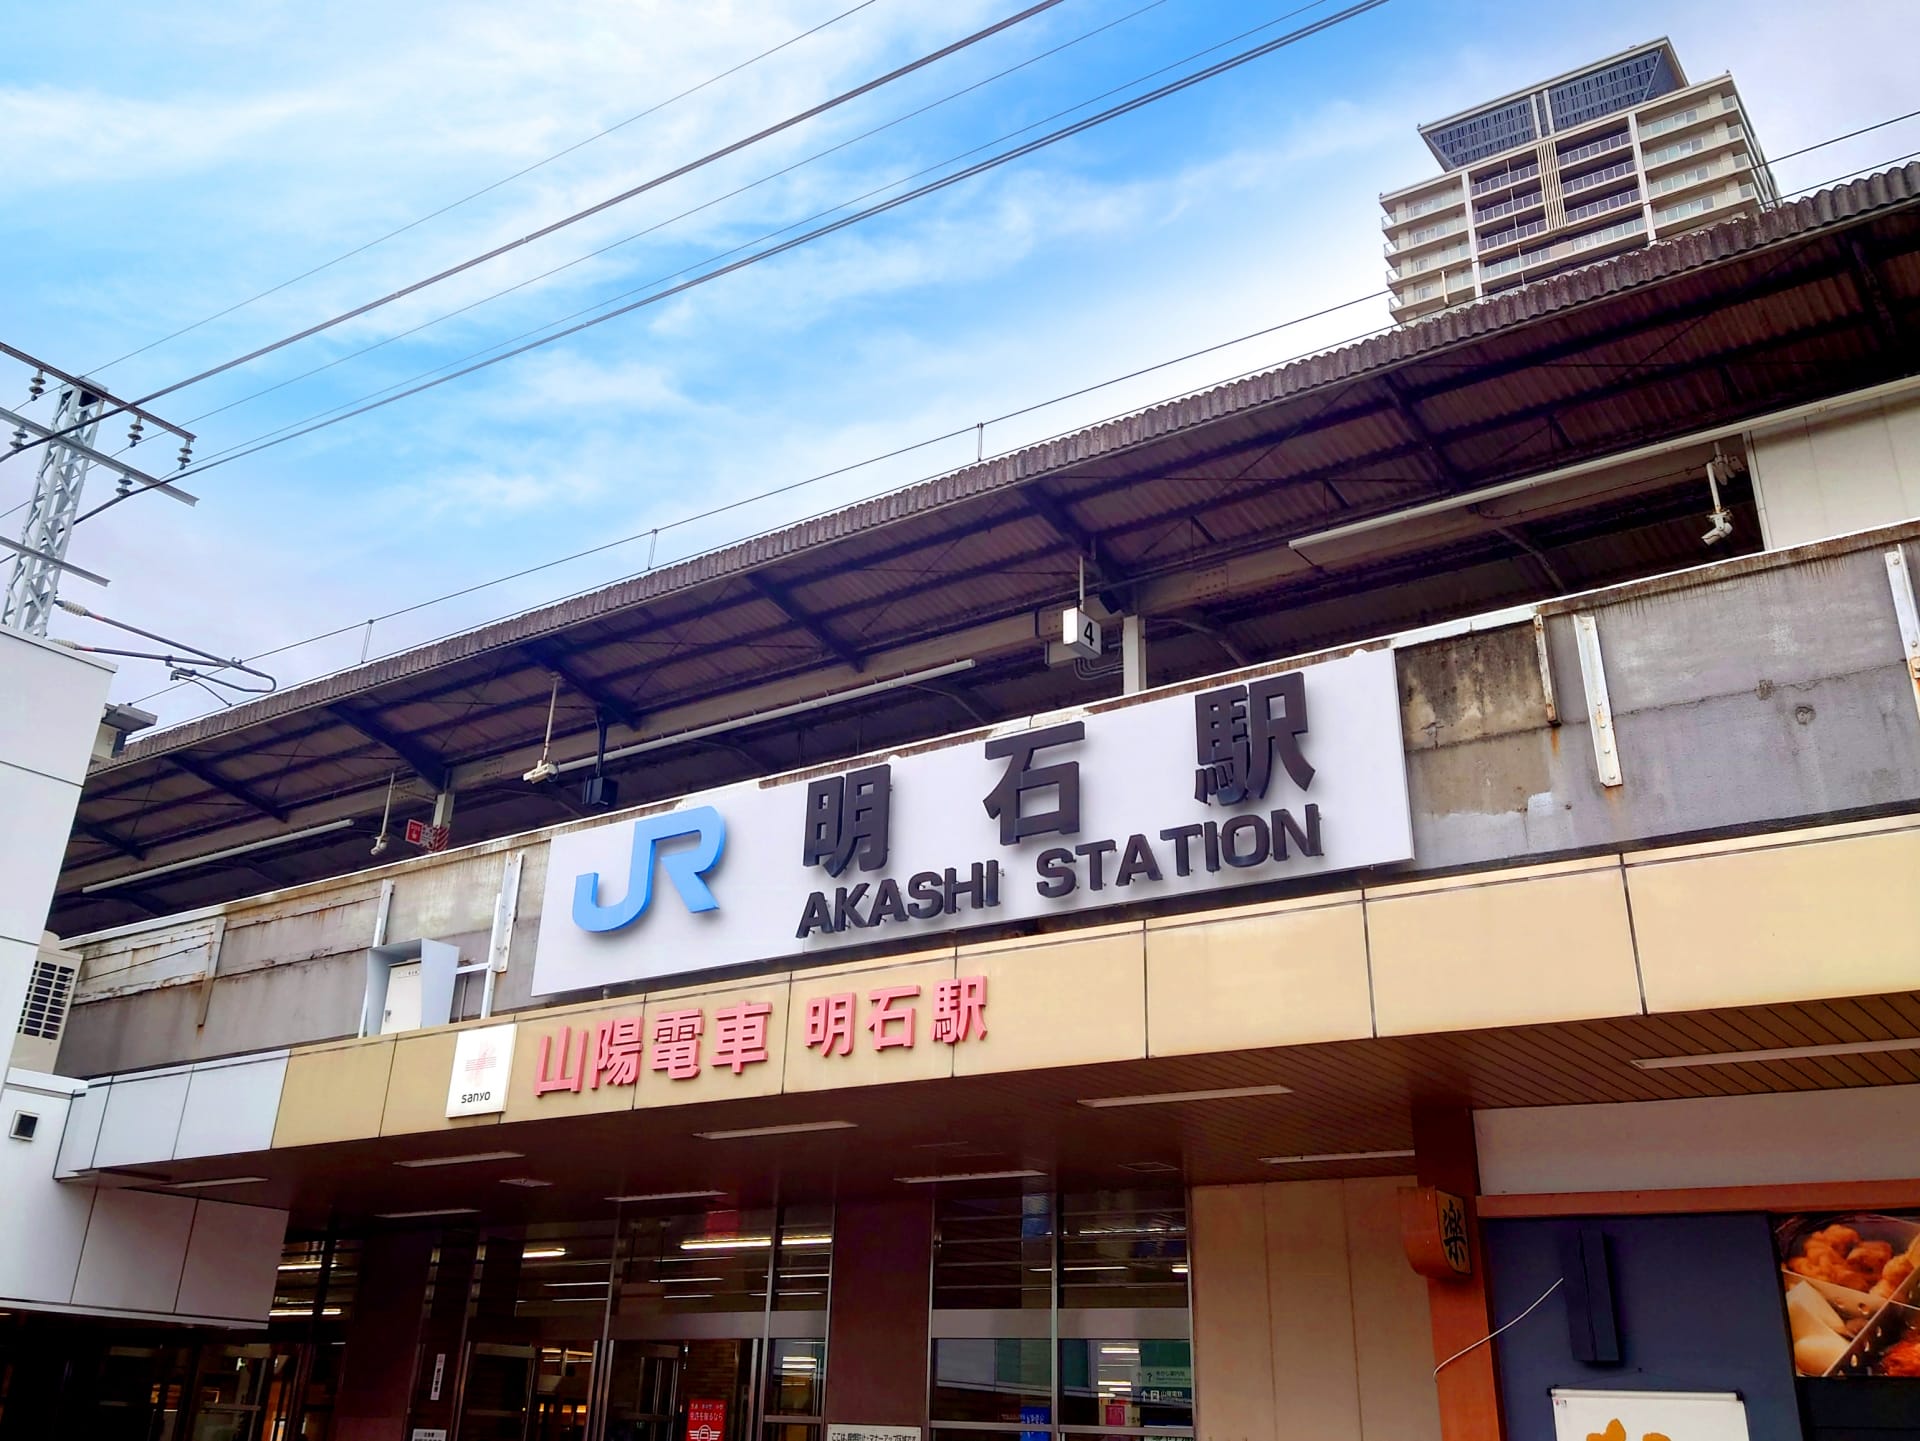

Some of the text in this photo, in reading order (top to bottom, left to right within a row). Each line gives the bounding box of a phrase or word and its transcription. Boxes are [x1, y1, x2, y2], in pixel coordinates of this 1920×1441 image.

[1083, 621, 1095, 646] 4
[802, 671, 1316, 878] 明石駅
[572, 805, 727, 933] JR
[796, 803, 1323, 939] AKASHI STATION
[461, 1091, 491, 1104] sanyo
[534, 975, 988, 1097] 山陽電車 明石駅
